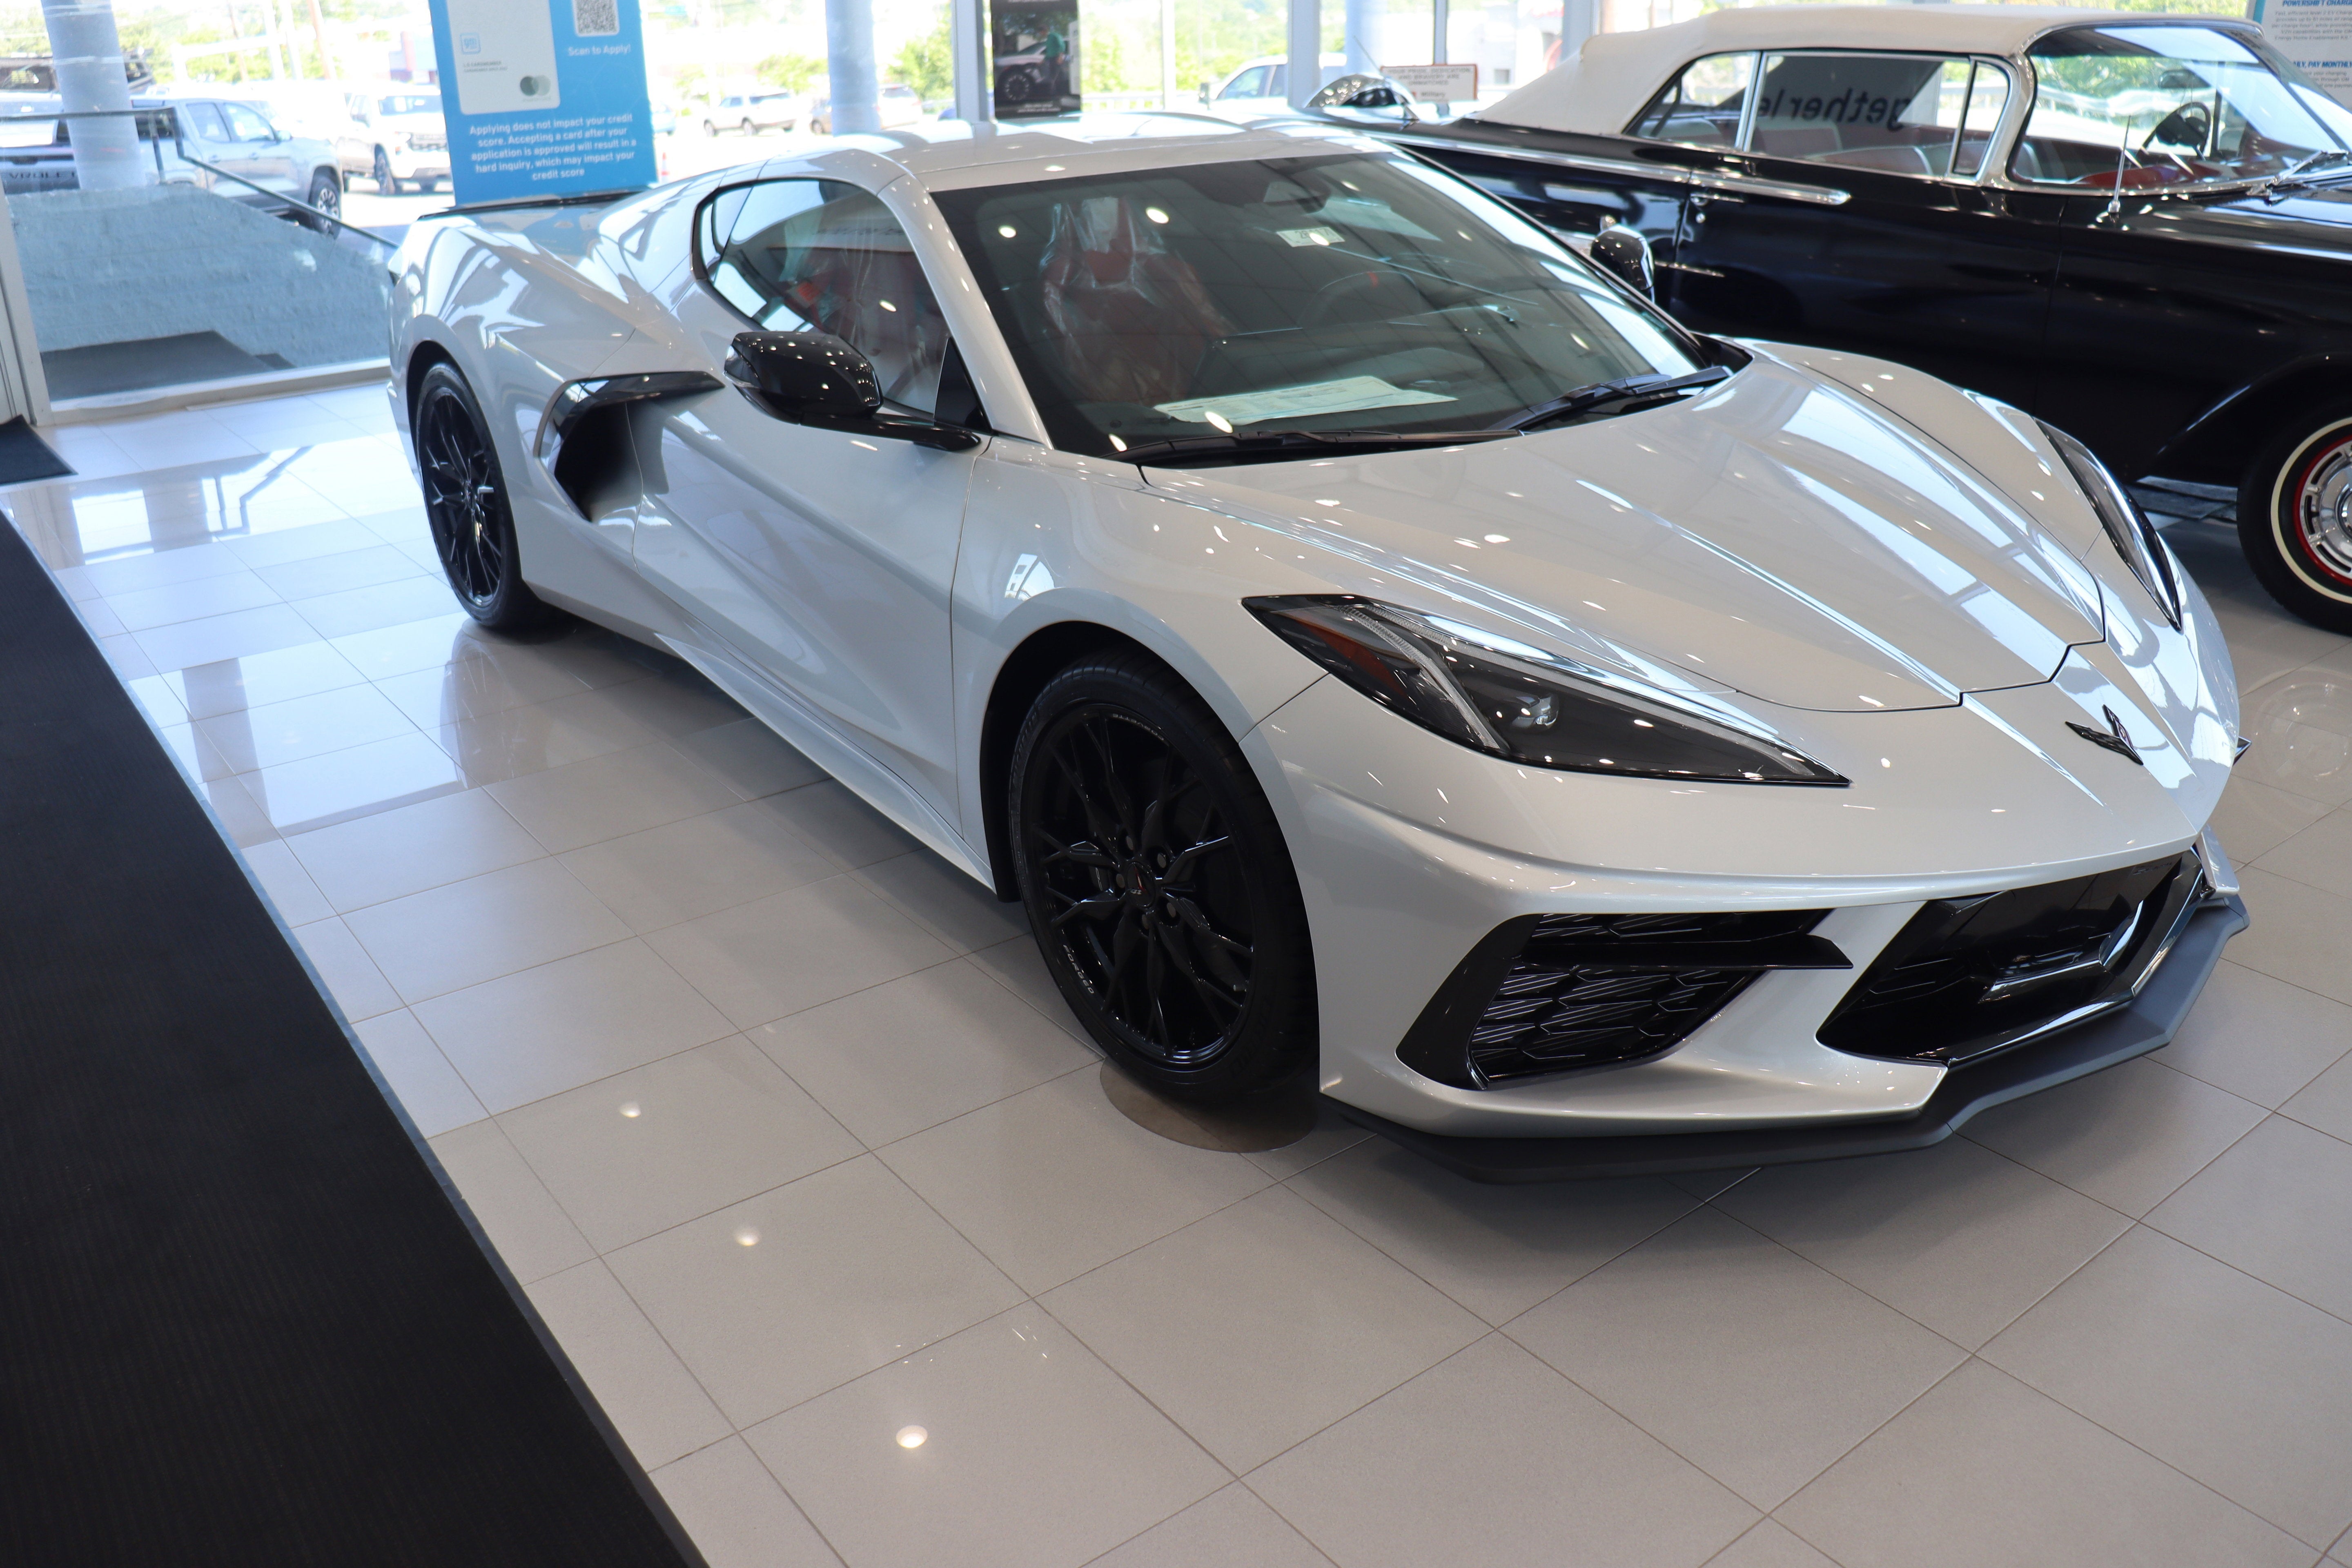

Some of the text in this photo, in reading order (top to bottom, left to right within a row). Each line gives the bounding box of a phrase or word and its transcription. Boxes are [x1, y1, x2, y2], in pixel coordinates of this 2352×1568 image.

[568, 44, 631, 56] Scan to Apply!
[470, 113, 633, 136] Applying does not impact your credit
[478, 138, 506, 147] score.
[508, 134, 554, 144] Accepting
[563, 130, 583, 140] card
[585, 129, 606, 138] after
[608, 128, 627, 137] your
[471, 149, 523, 161] application
[524, 147, 532, 155] is
[534, 143, 575, 156] approved
[577, 141, 592, 151] will
[594, 139, 619, 149] result
[621, 138, 629, 147] in
[476, 152, 635, 174] hard inquiry, which may impact your
[532, 168, 585, 180] credit score
[1112, 713, 1164, 741] CORVETTE
[1062, 944, 1095, 994] FORGED
